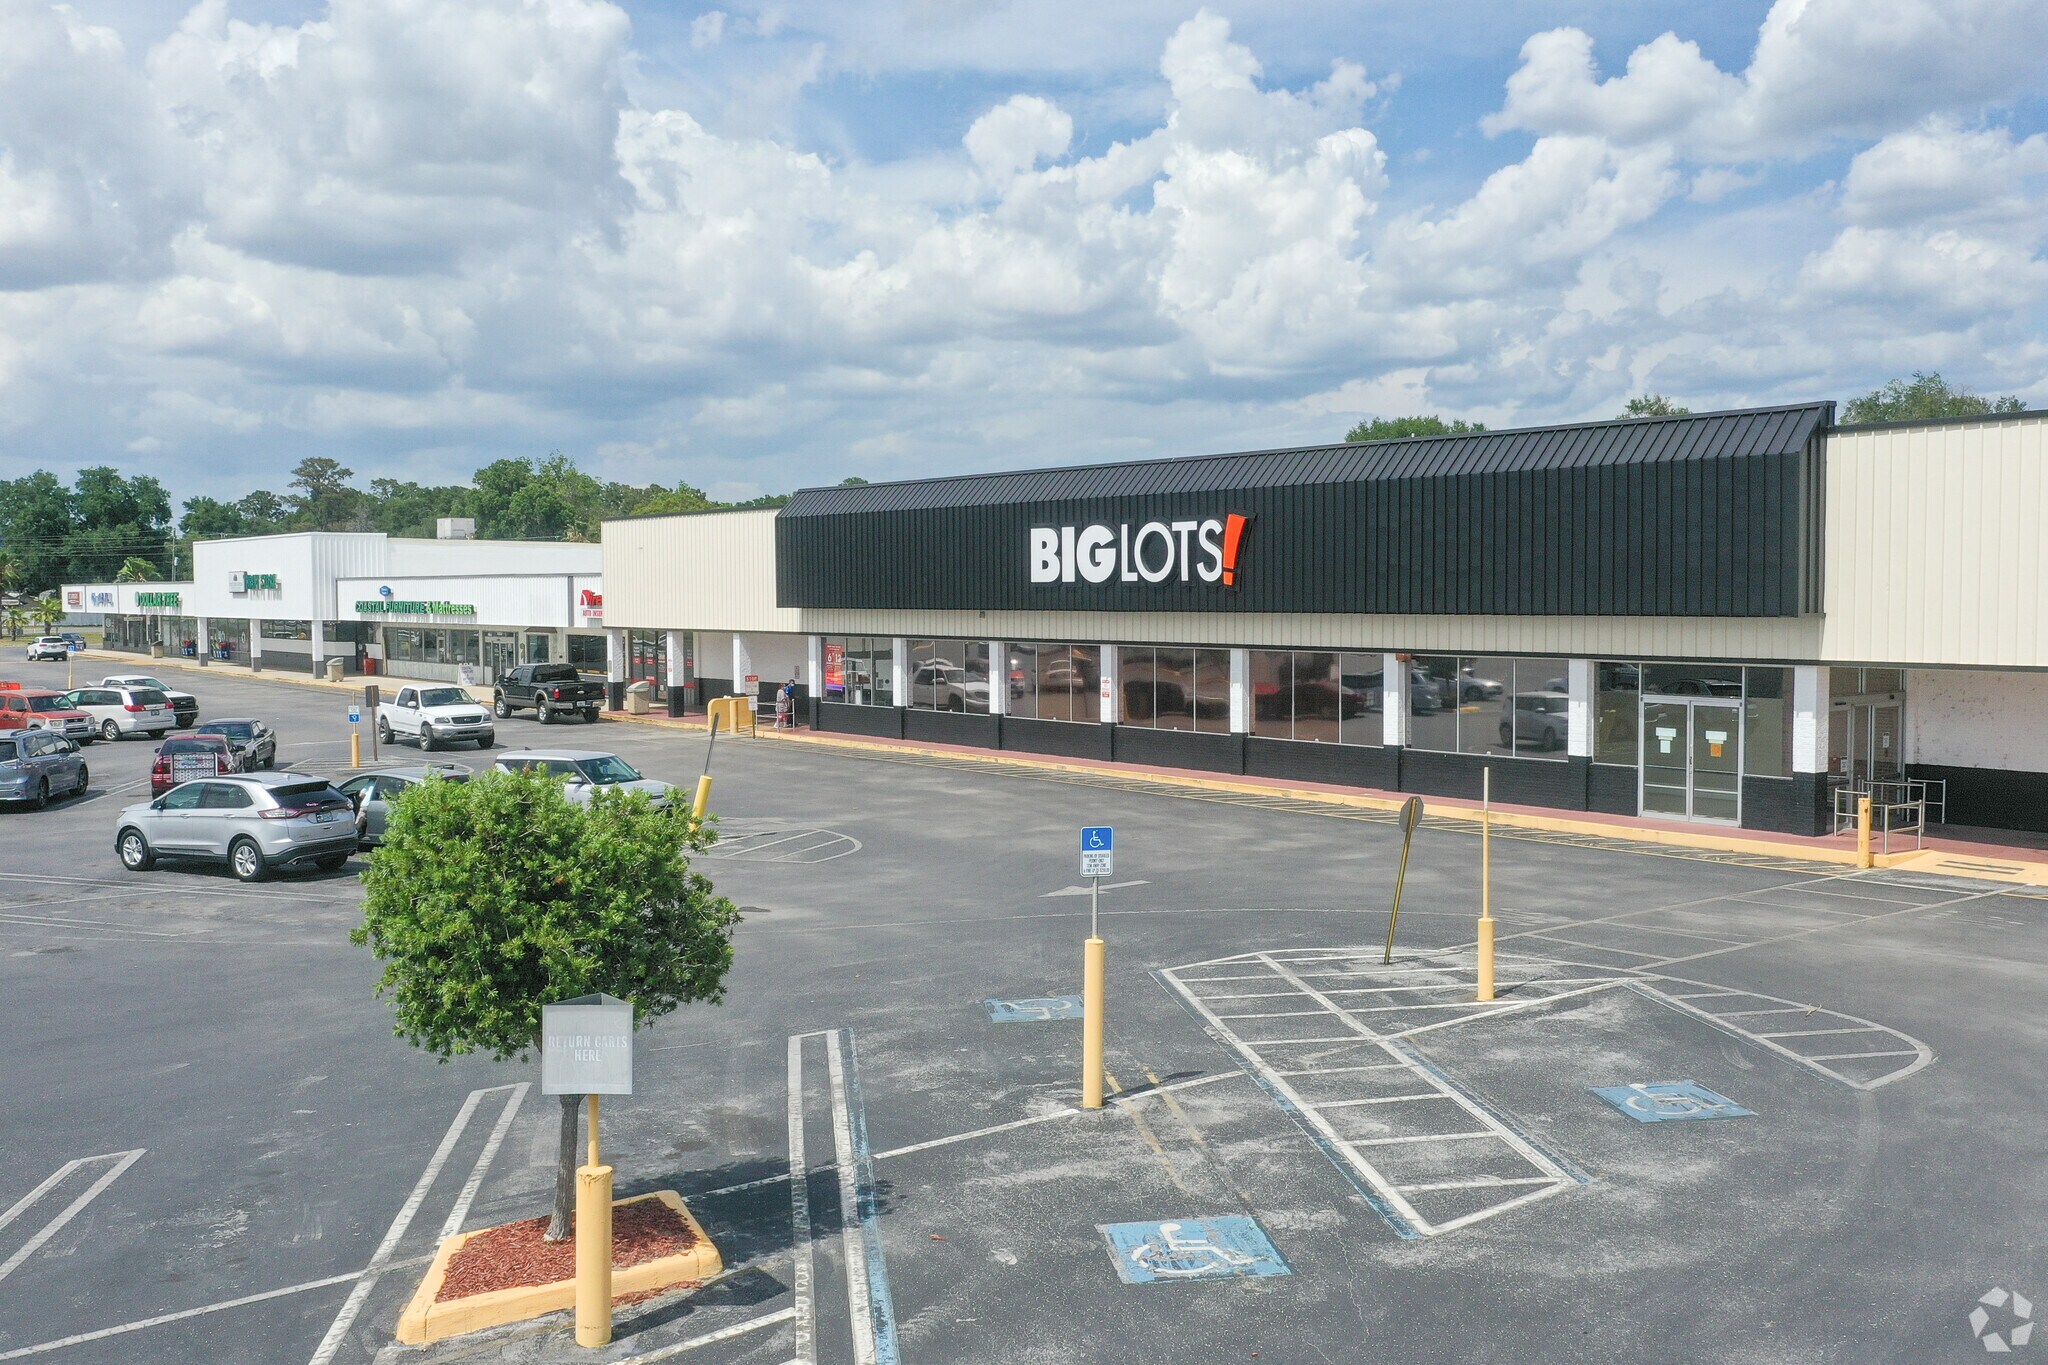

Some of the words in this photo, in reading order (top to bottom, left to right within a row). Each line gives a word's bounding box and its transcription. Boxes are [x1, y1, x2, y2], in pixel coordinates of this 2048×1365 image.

[140, 592, 163, 606] DOLLAR
[355, 600, 385, 612] COASTAL
[386, 600, 426, 613] FURNITURE
[432, 600, 475, 615] Mattresses
